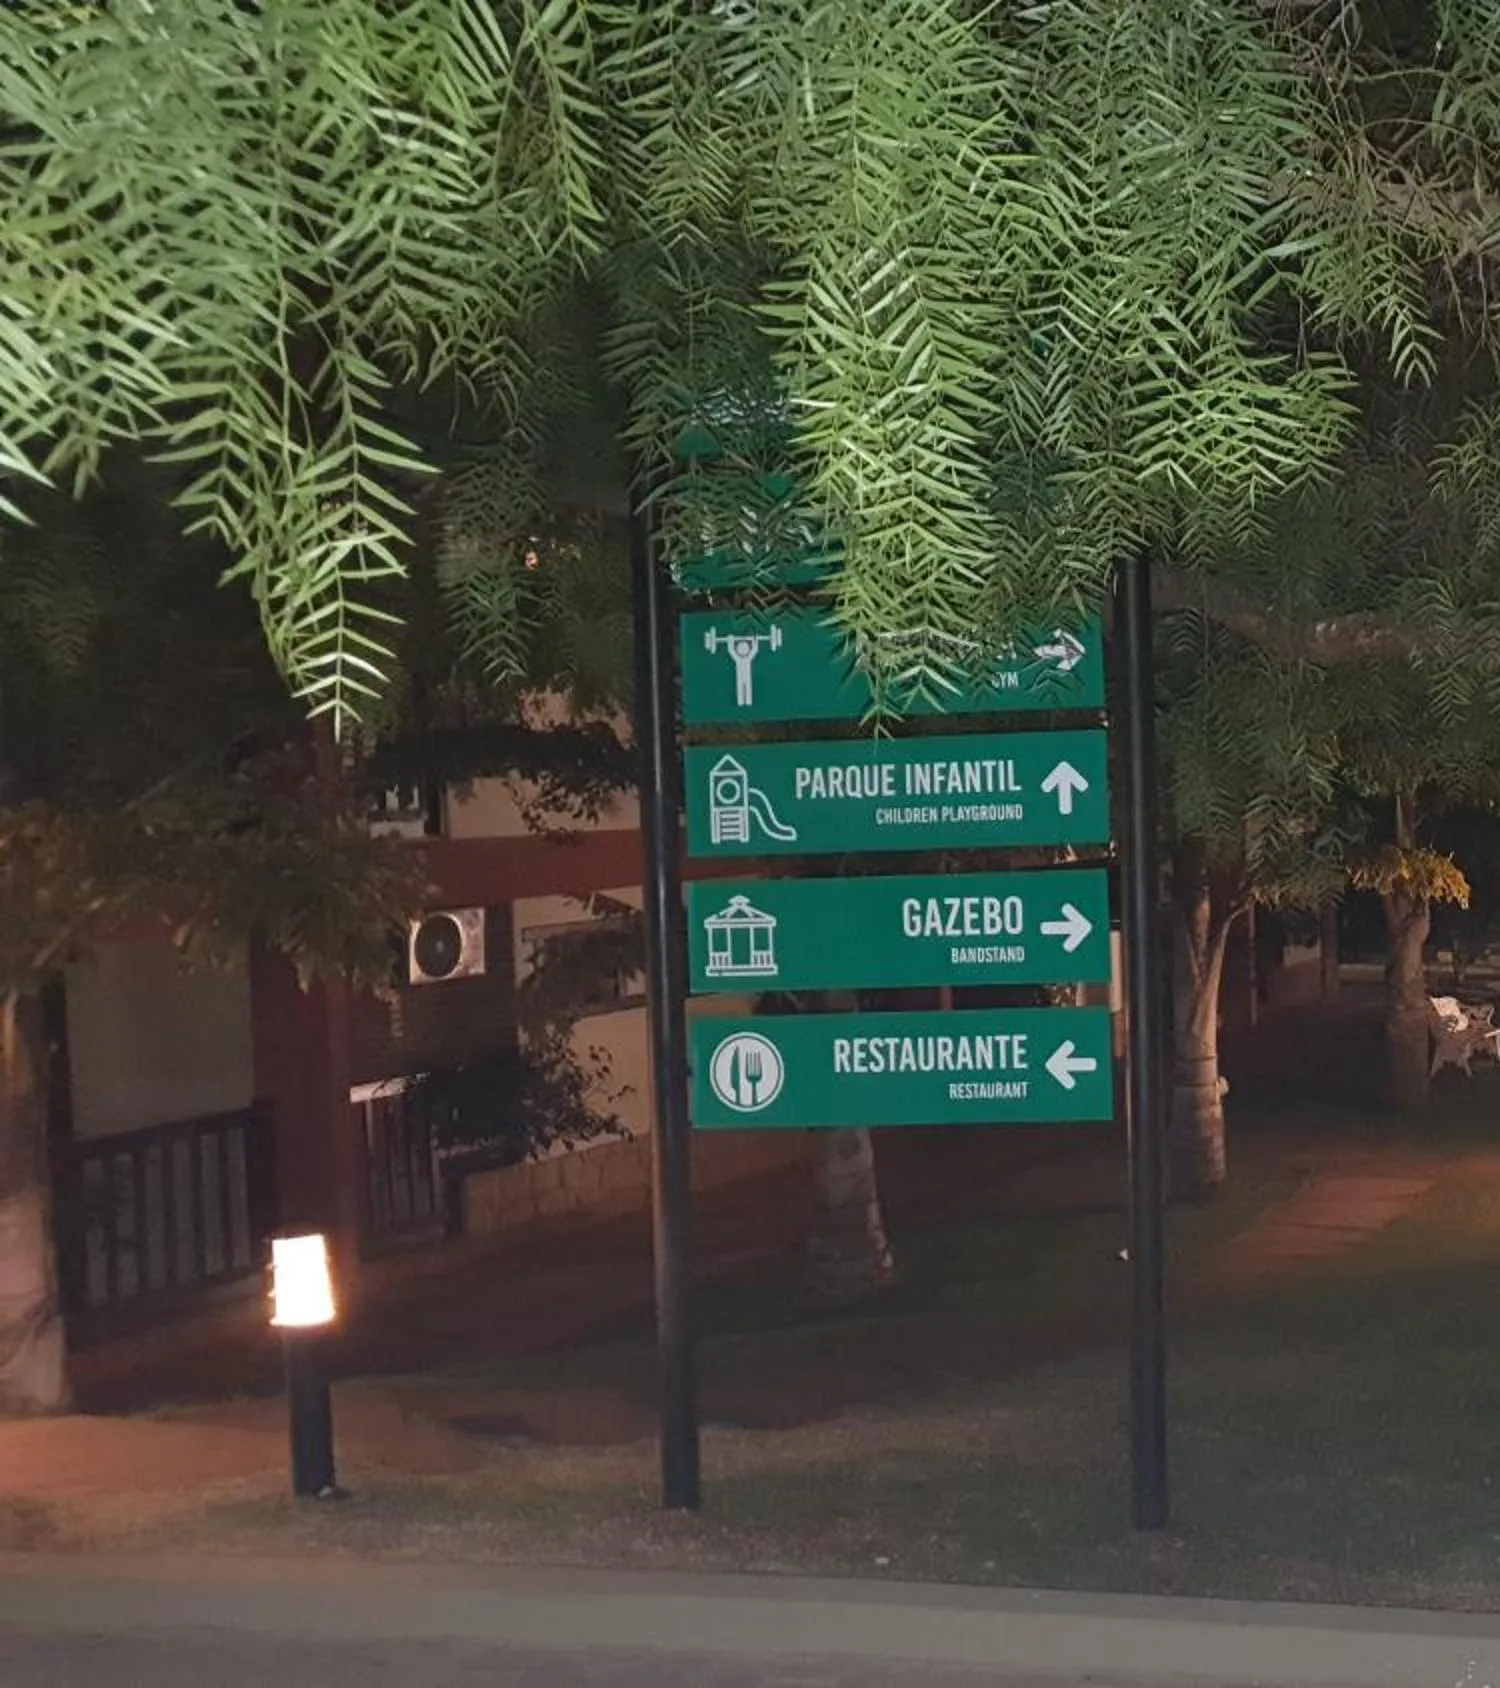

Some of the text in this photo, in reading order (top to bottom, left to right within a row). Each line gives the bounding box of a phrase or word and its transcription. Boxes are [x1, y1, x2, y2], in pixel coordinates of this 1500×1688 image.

[796, 760, 1022, 799] PARQUE INFANTIL
[876, 804, 1023, 824] CHILDREN PLAYGROUND
[903, 896, 1024, 937] GAZEBO
[951, 946, 1025, 963] BANDSTAND
[834, 1035, 1028, 1073] RESTAURANTE
[949, 1082, 1028, 1099] RESTAURANT
